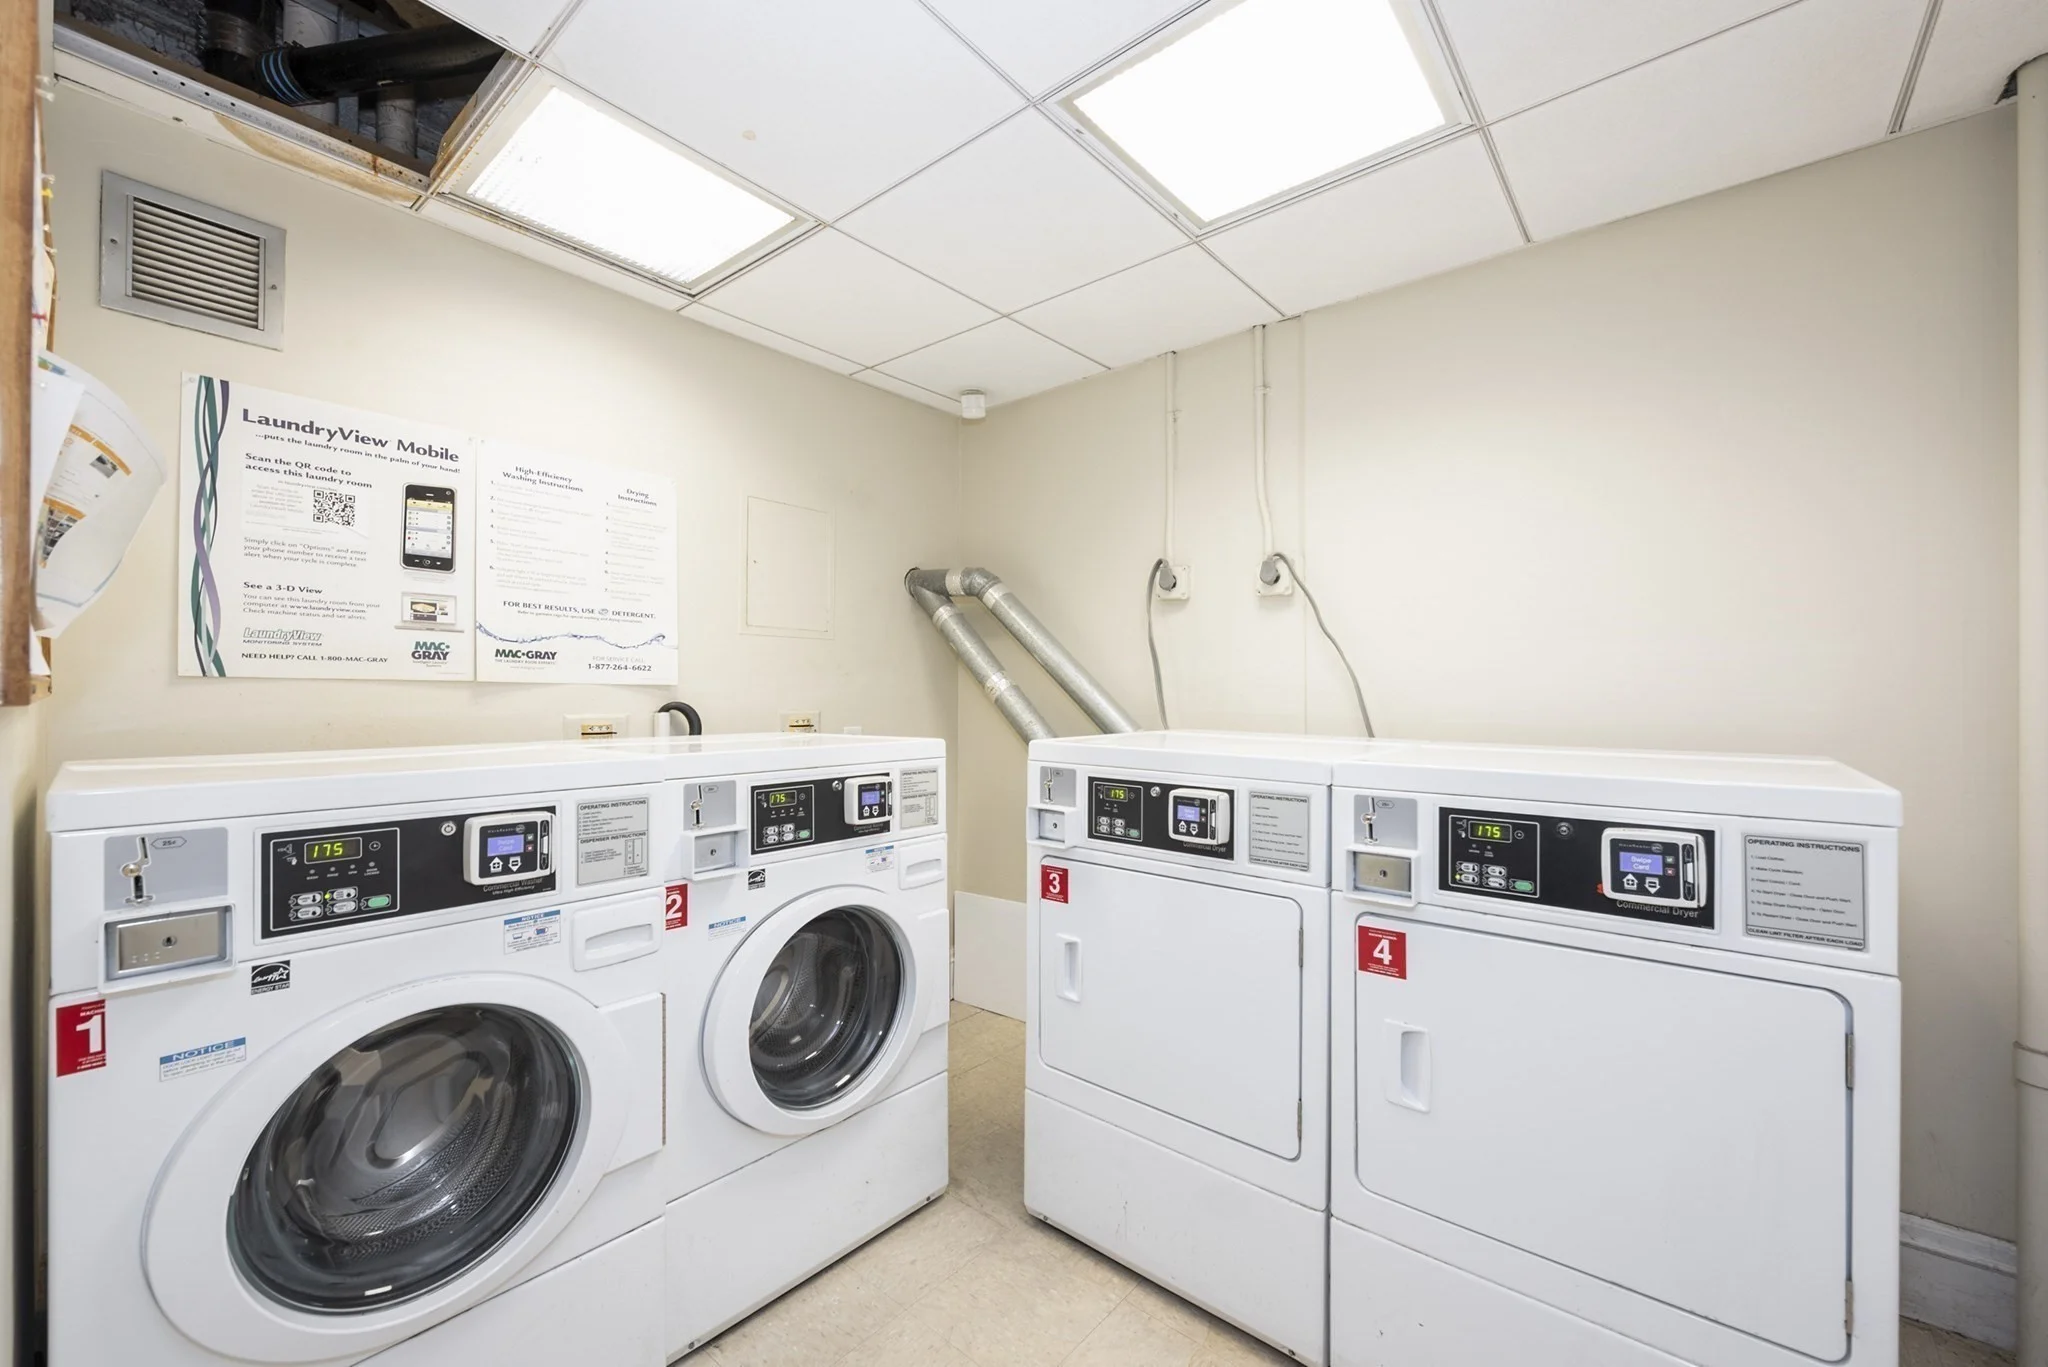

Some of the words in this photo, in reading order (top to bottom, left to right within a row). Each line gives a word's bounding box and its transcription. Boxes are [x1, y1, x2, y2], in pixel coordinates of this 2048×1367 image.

[243, 408, 388, 448] LaundryView
[397, 439, 459, 462] Mobile
[287, 435, 302, 445] the
[304, 440, 338, 452] laundry
[339, 447, 363, 456] room
[364, 450, 373, 458] in
[374, 452, 388, 460] the
[389, 456, 410, 465] palm
[421, 462, 438, 470] your
[245, 452, 272, 464] Scan
[274, 458, 292, 467] the
[294, 461, 312, 470] QR
[314, 465, 338, 475] code
[340, 469, 352, 477] to
[244, 463, 281, 475] access
[283, 466, 303, 477] this
[305, 470, 344, 484] laundry
[346, 478, 373, 489] room
[515, 465, 573, 483] High-Efficiency
[502, 471, 537, 485] Washing
[538, 478, 584, 493] Instructions
[617, 493, 658, 507] Instructions
[626, 488, 650, 499] Drying
[243, 537, 269, 546] Simply
[243, 545, 261, 553] your
[262, 546, 284, 555] phone
[286, 549, 314, 557] number
[243, 551, 261, 559] alert
[262, 553, 282, 561] when
[283, 556, 300, 564] your
[301, 557, 317, 565] cycle
[243, 581, 263, 590] See
[275, 584, 296, 592] 3-D
[298, 585, 323, 595] View
[242, 593, 257, 601] You
[301, 597, 328, 606] laundry
[349, 600, 365, 608] from
[242, 601, 278, 609] computer
[503, 600, 521, 608] FOR
[522, 601, 543, 610] BEST
[544, 603, 580, 614] RESULTS,
[581, 607, 596, 615] USE
[242, 607, 266, 615] Check
[267, 609, 298, 617] machine
[242, 627, 323, 642] LaundryView
[241, 652, 267, 660] NEED
[268, 653, 295, 661] HELP?
[320, 655, 389, 663] 1-800-MAC-GRAY
[411, 650, 450, 661] GRAY
[587, 663, 653, 672] 1-877-264-6622
[771, 793, 785, 803] 175
[1111, 789, 1124, 799] 175
[580, 803, 610, 811] OPERATING
[611, 800, 647, 808] INSTRUCTIONS
[611, 832, 647, 840] INSTRUCTIONS
[1478, 825, 1501, 838] 175
[313, 842, 343, 858] 175
[1748, 838, 1795, 848] OPERATING
[1796, 842, 1861, 853] INSTRUCTIONS
[1631, 856, 1652, 864] Swipe
[483, 880, 520, 893] Commercial
[1049, 872, 1060, 894] 3
[666, 894, 682, 920] 2
[1616, 900, 1670, 914] Commercial
[1672, 907, 1699, 919] Dryer
[521, 913, 545, 922] NOTICE
[714, 917, 741, 928] NOTICE
[1748, 927, 1768, 935] CLEAN
[1783, 932, 1804, 940] FILTER
[1845, 939, 1863, 947] LOAD
[1373, 938, 1393, 965] 4
[251, 985, 275, 995] ENERGY
[275, 981, 291, 990] STAR
[76, 1014, 102, 1054] 1
[172, 1040, 235, 1061] NOTICE
